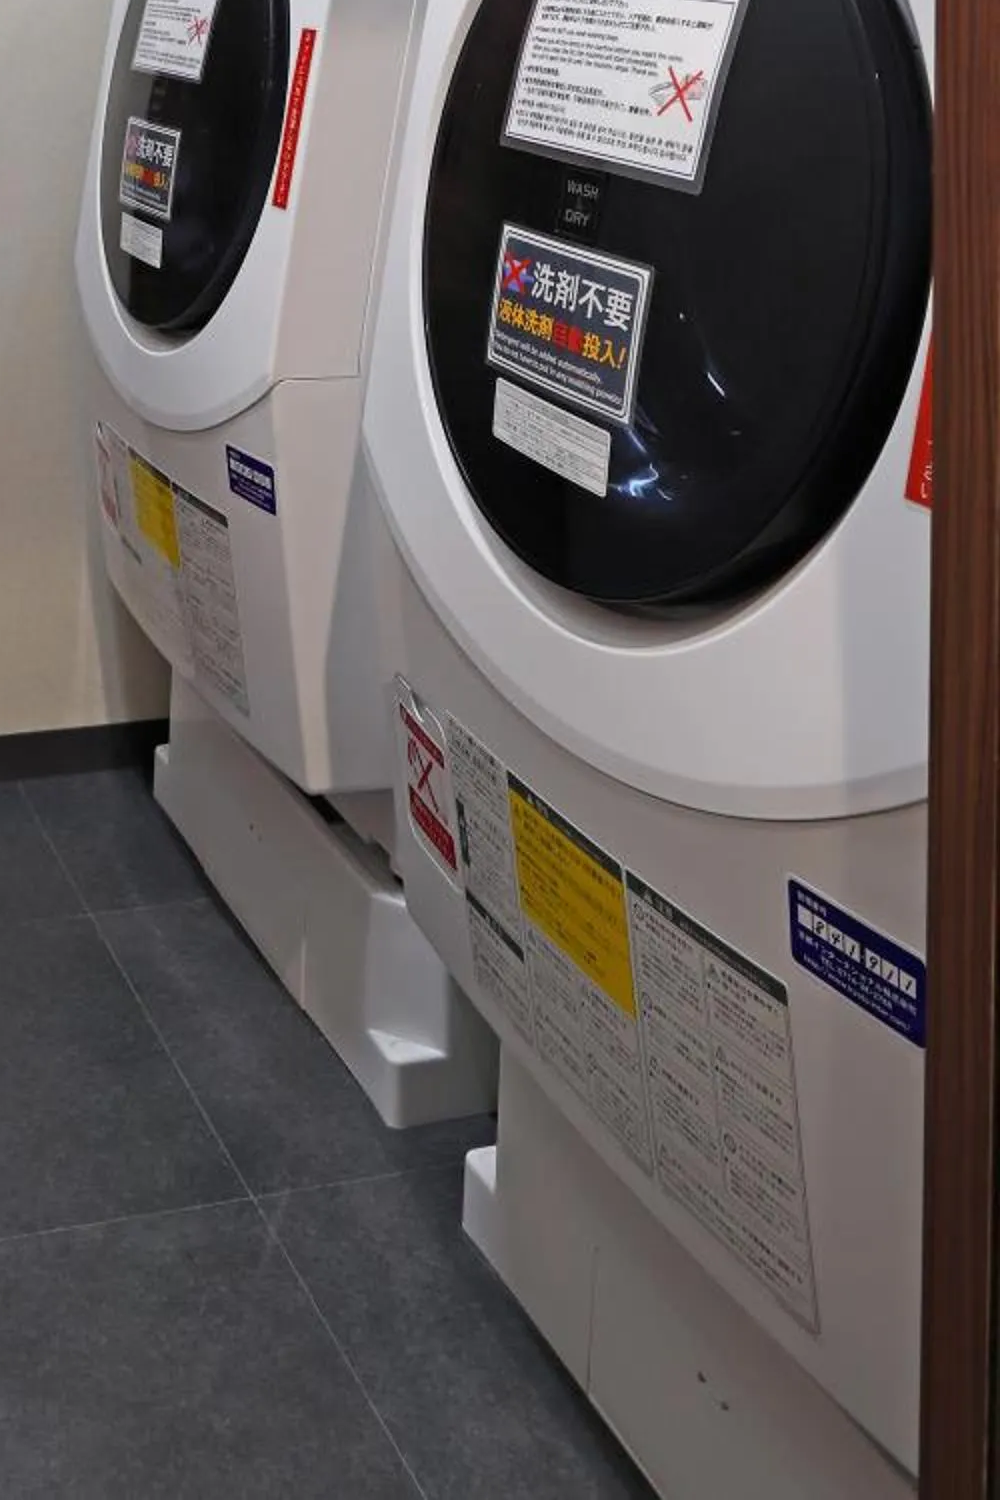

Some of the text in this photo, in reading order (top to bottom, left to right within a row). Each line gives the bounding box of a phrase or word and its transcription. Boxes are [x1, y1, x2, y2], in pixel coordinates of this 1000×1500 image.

[566, 179, 600, 201] WASH
[564, 208, 591, 228] DRY
[531, 261, 633, 332] 洗剤不要
